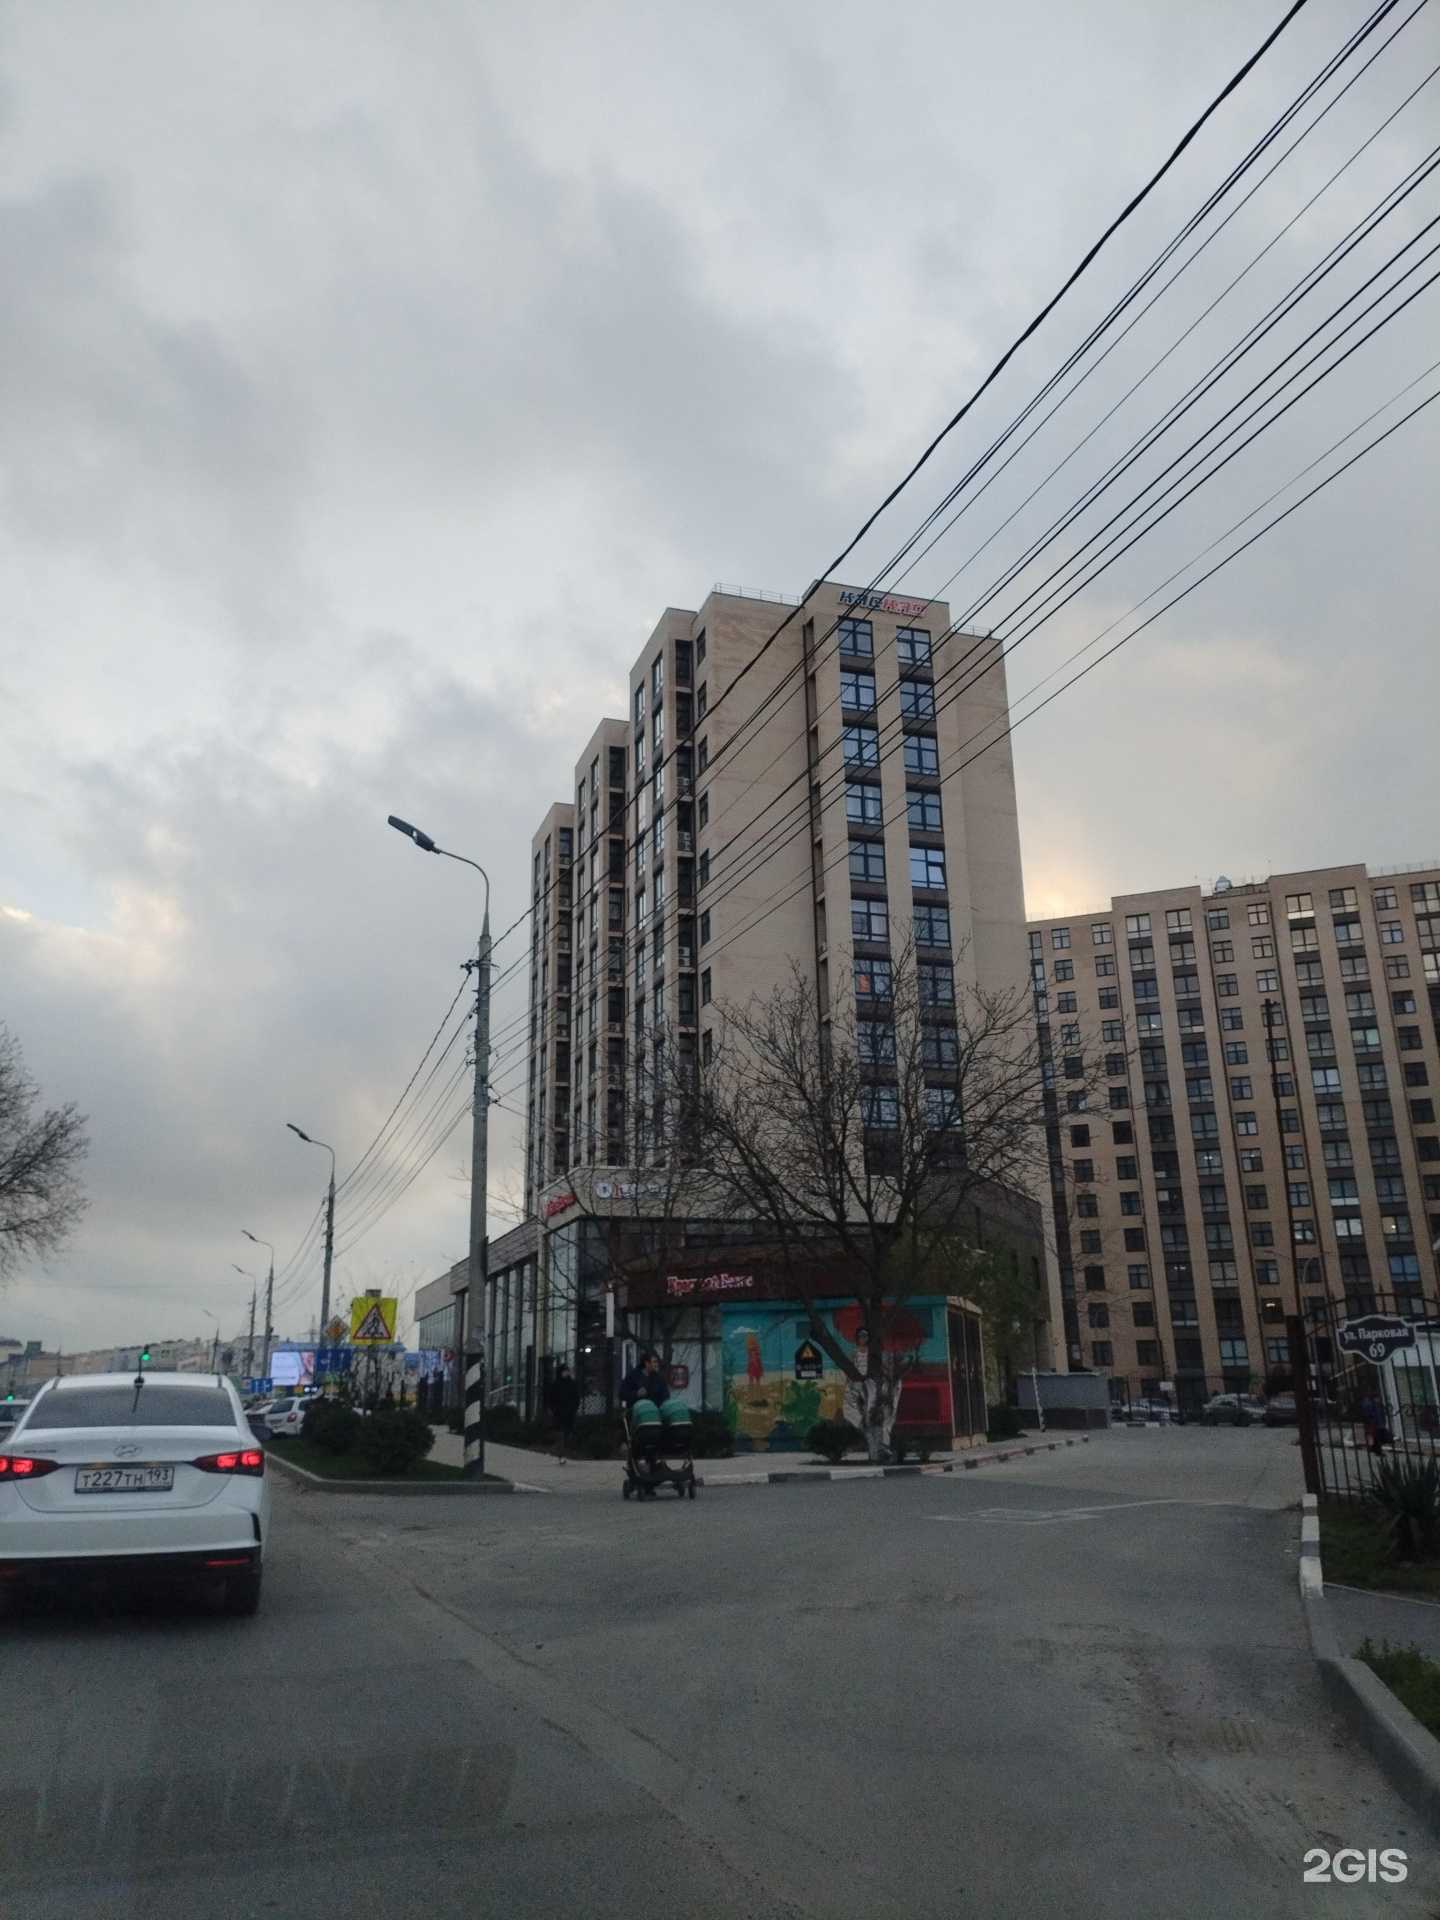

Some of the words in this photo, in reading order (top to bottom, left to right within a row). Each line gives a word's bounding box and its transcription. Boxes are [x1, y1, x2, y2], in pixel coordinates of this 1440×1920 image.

[1358, 1328, 1409, 1341] Парковая
[1369, 1342, 1386, 1358] 69
[147, 1467, 169, 1481] 193
